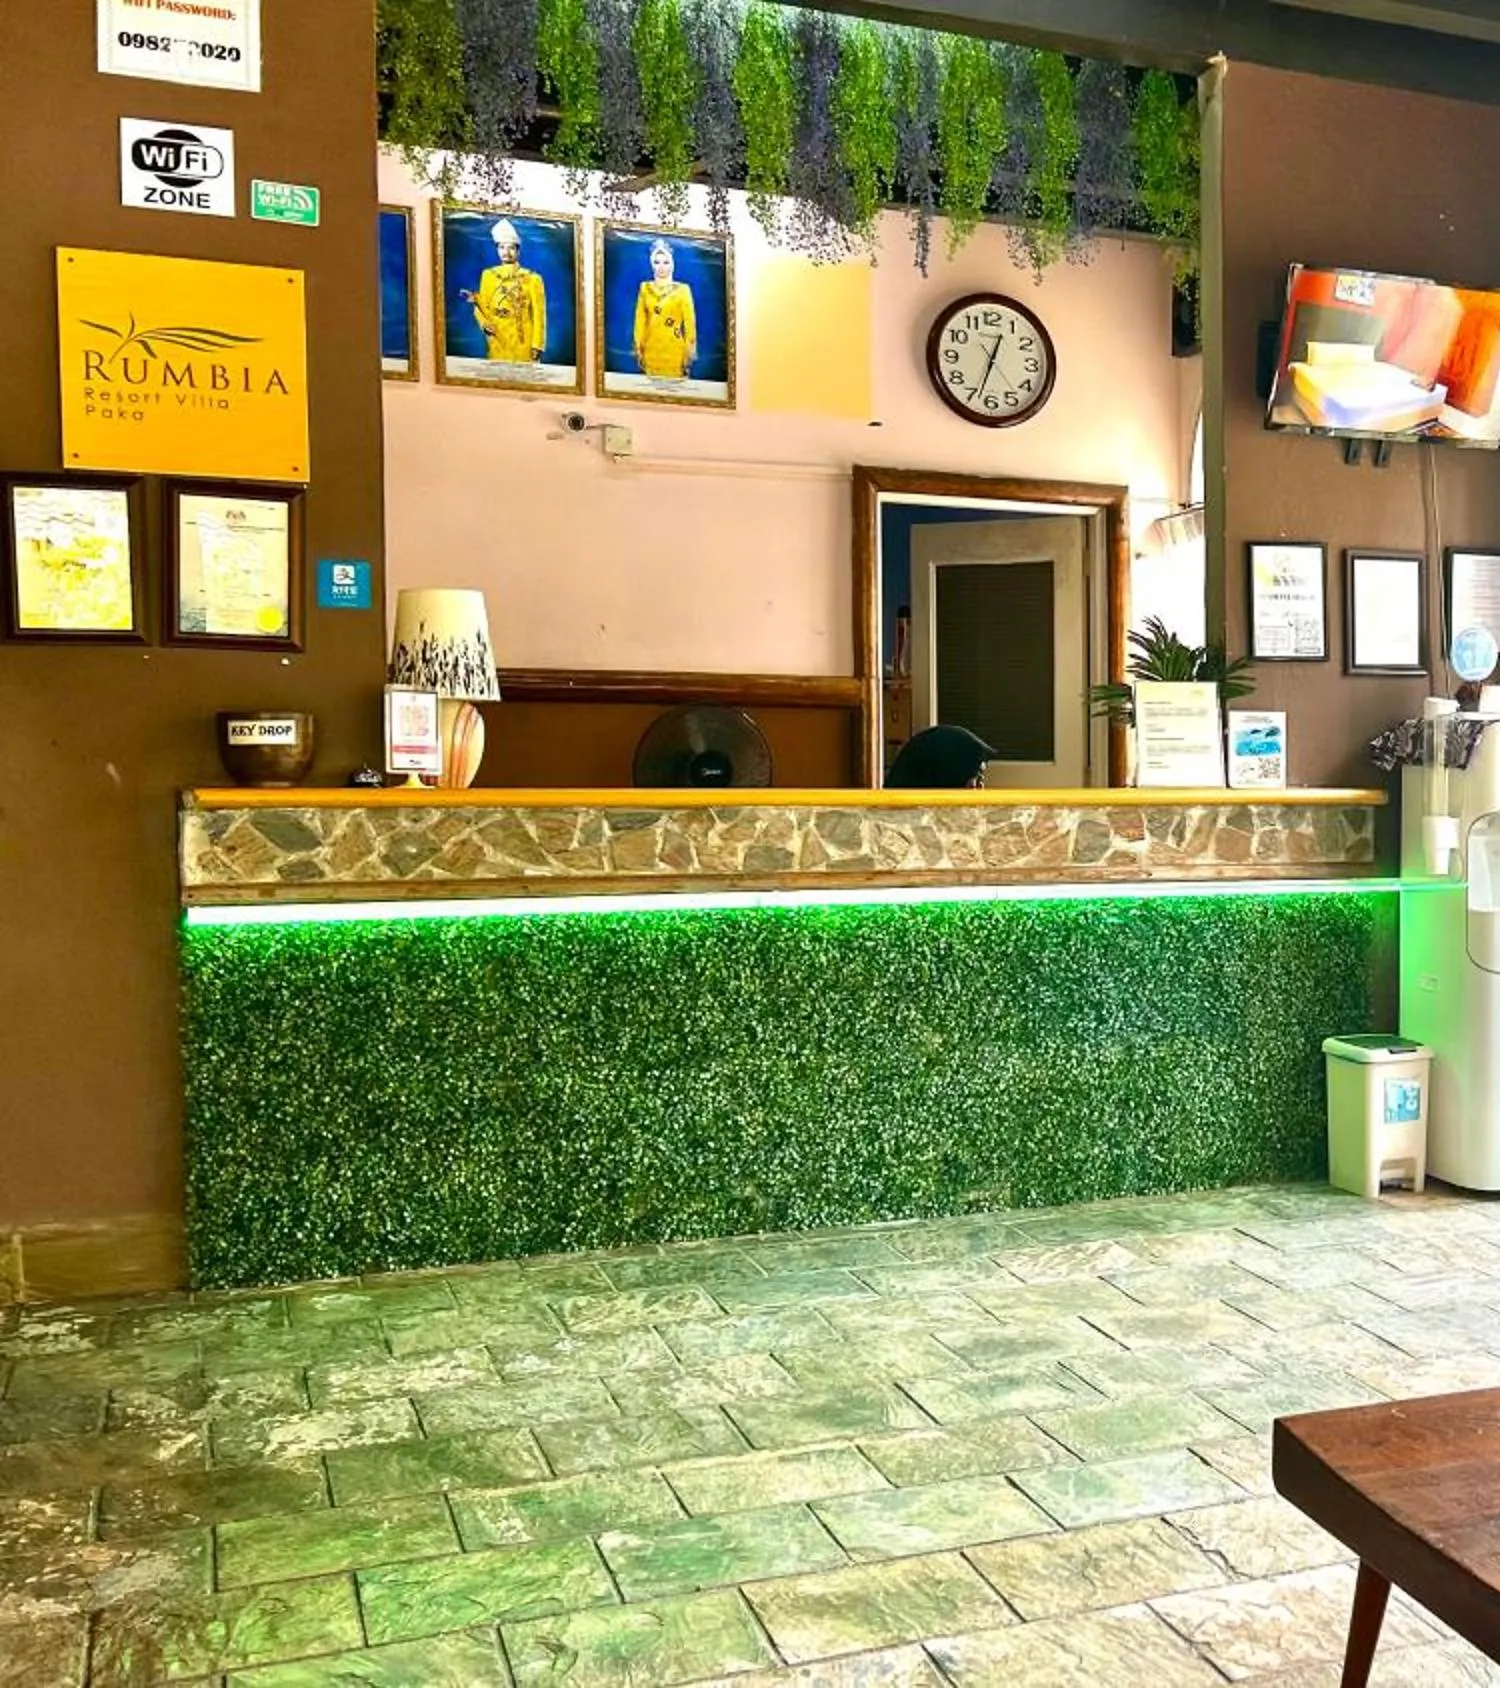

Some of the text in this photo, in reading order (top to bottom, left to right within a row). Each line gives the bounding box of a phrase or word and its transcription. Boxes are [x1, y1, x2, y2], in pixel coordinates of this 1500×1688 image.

[155, 0, 237, 20] PASSWORD:
[143, 186, 211, 209] ZONE
[965, 315, 979, 331] 11
[982, 311, 1003, 327] 12
[1009, 319, 1016, 335] 1
[949, 328, 969, 345] 10
[1018, 336, 1034, 352] 2
[943, 349, 960, 364] 9
[83, 349, 290, 396] RUMBIA
[1024, 357, 1040, 373] 3
[949, 370, 965, 386] 8
[1018, 378, 1033, 393] 4
[84, 386, 229, 410] Resort Villa
[963, 386, 979, 403] 7
[983, 394, 1000, 410] 6
[1003, 391, 1020, 407] 5
[85, 403, 145, 422] Paka
[231, 723, 293, 736] KEY DROP
